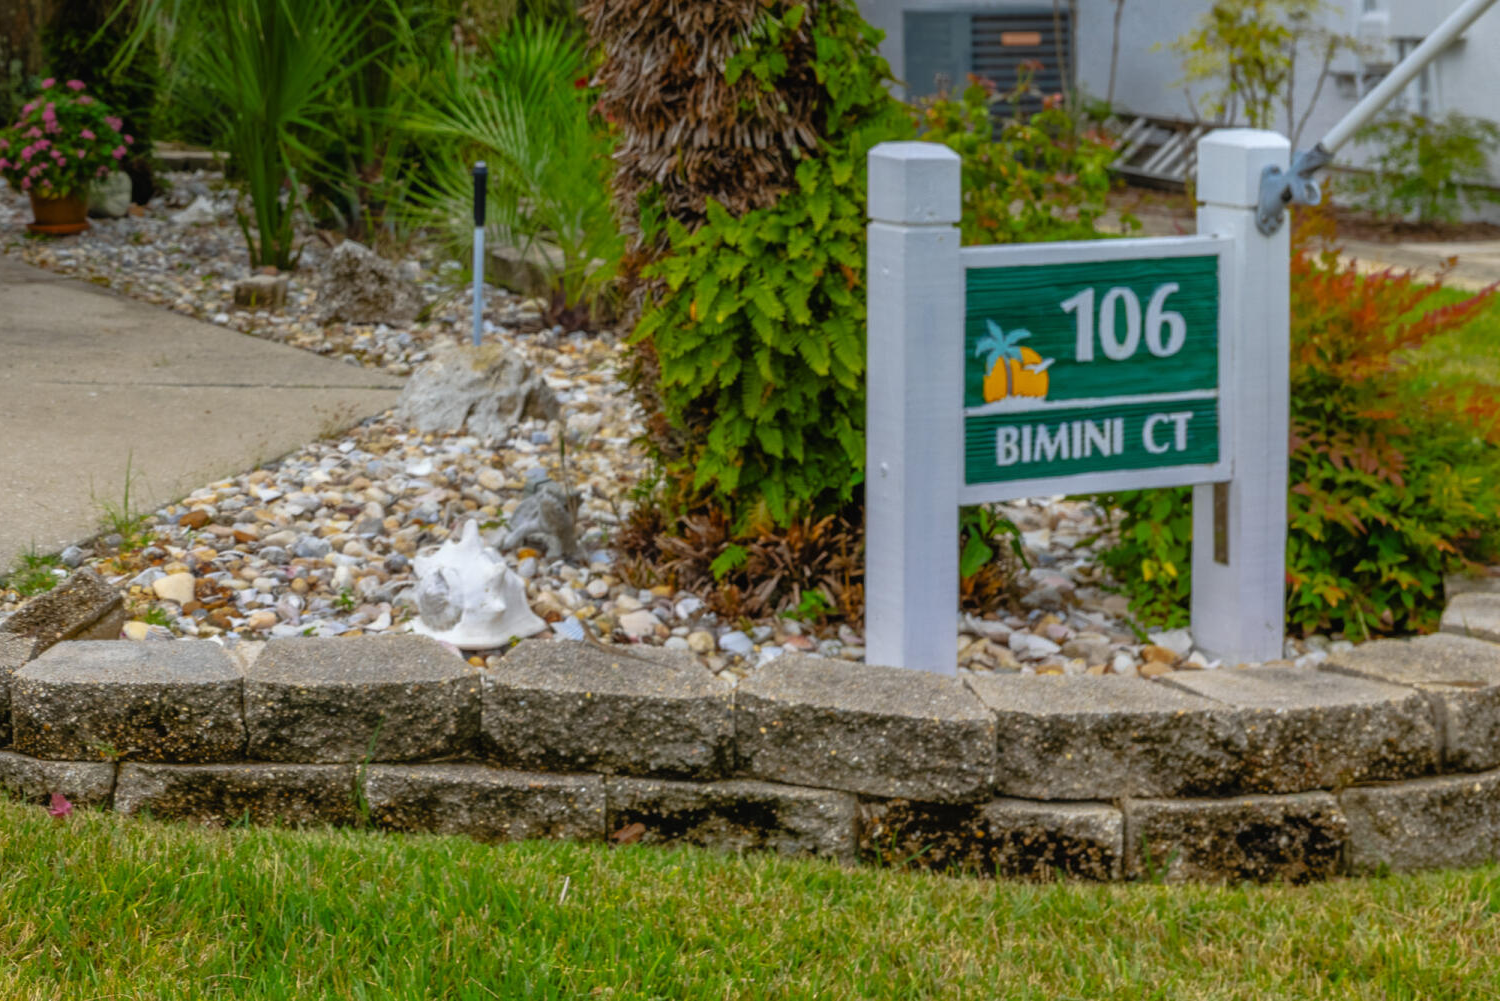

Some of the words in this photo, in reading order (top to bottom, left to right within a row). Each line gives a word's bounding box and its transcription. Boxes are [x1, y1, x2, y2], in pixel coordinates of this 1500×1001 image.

[1060, 282, 1186, 362] 106
[996, 418, 1124, 466] BIMINI
[1142, 411, 1194, 454] CT
